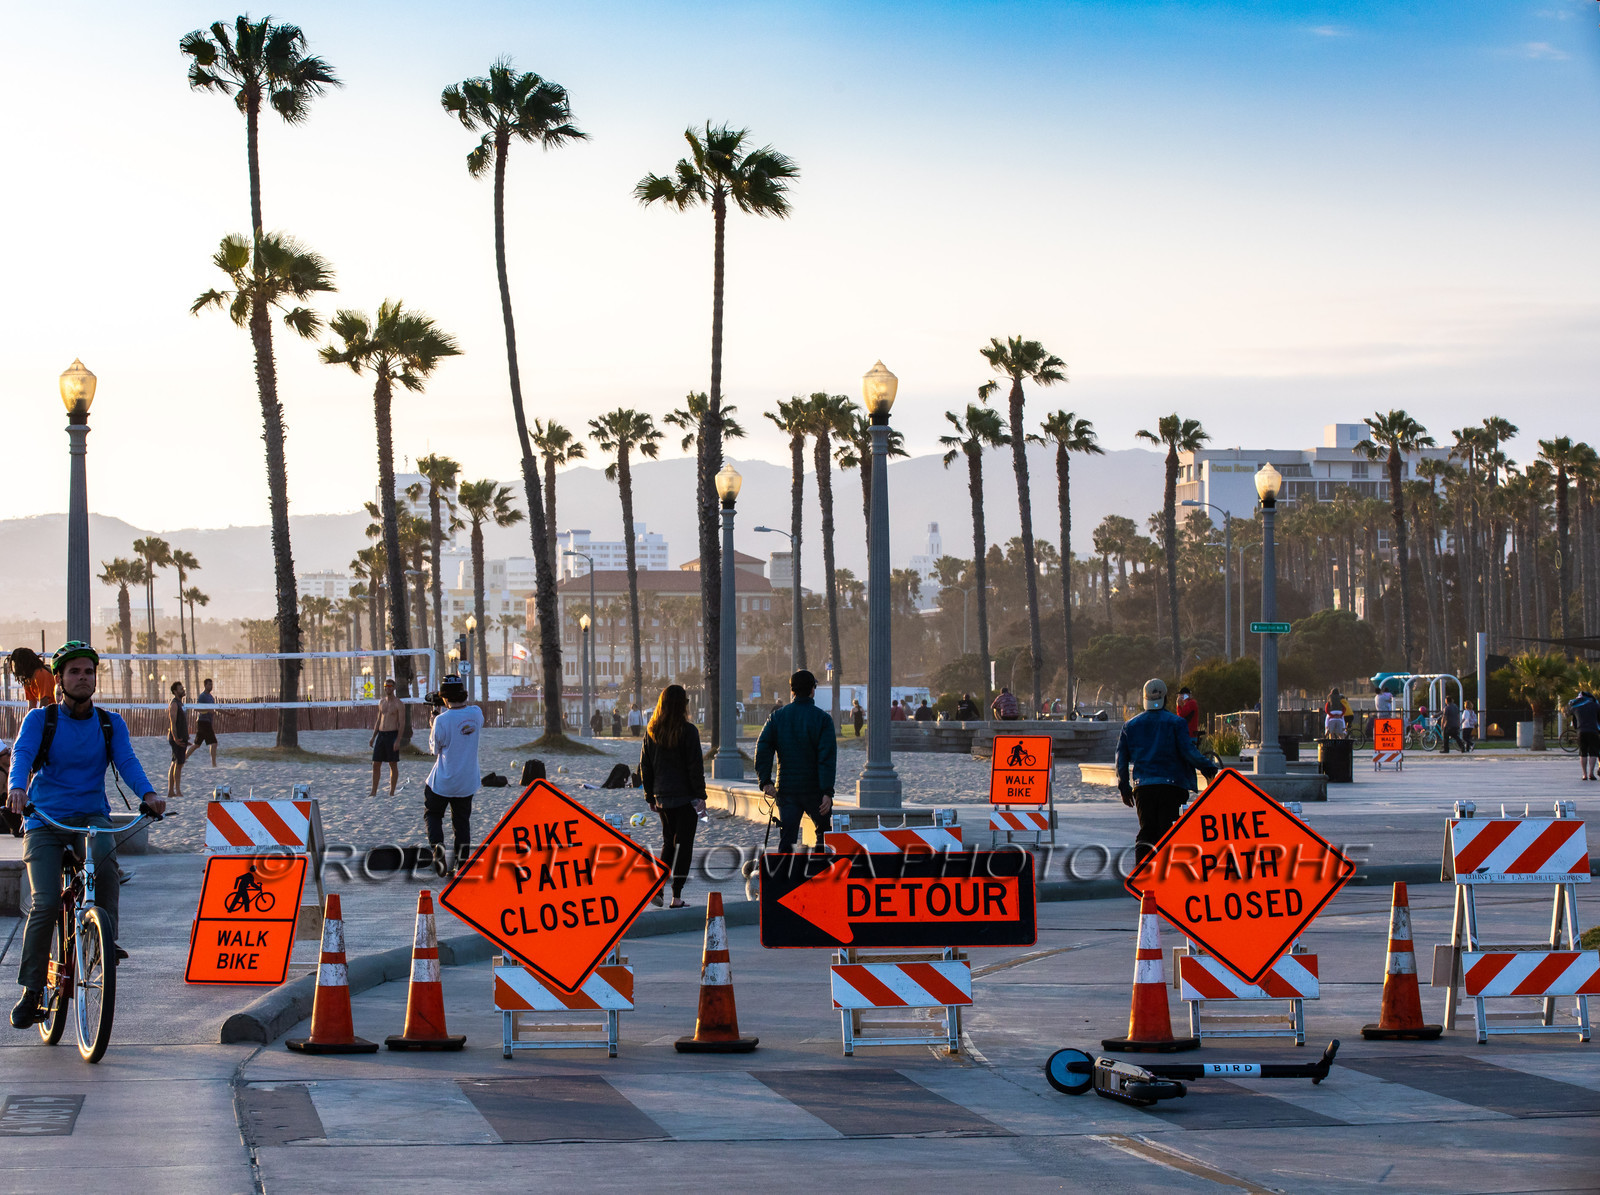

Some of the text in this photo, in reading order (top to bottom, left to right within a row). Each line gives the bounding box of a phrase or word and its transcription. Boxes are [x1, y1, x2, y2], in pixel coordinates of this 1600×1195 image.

[1006, 776, 1034, 784] WALK
[1008, 788, 1031, 796] BIKE
[512, 819, 583, 854] BIKE
[1200, 810, 1270, 843] BIKE
[514, 858, 594, 894] PATH
[1201, 849, 1279, 882] PATH
[846, 882, 1009, 917] DETOUR
[1185, 888, 1303, 923] CLOSED
[500, 896, 619, 937] CLOSED
[217, 930, 269, 947] WALK
[217, 953, 260, 970] BIKE
[1213, 1064, 1253, 1072] BIRD
